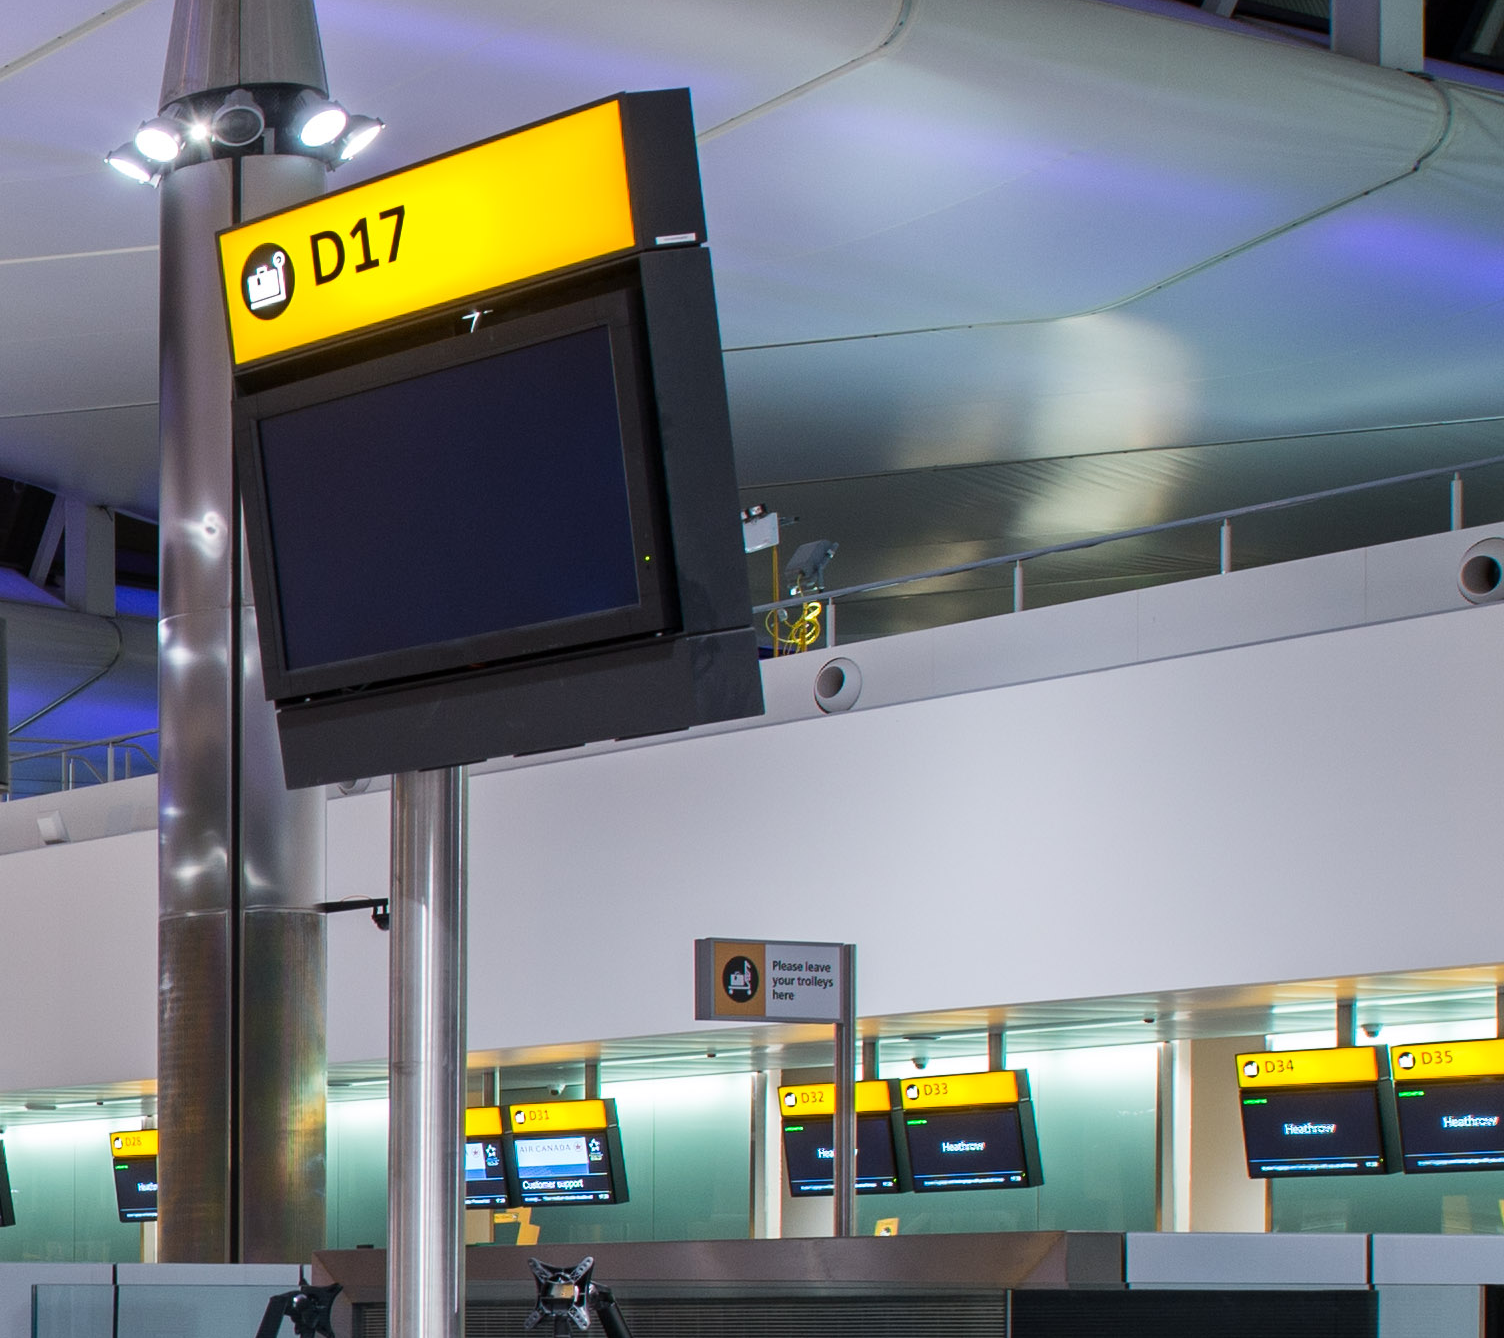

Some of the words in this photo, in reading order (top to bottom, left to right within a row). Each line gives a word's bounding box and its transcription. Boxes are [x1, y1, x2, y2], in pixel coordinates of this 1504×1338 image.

[309, 204, 406, 287] D17
[772, 960, 803, 972] Please
[804, 961, 832, 973] leave
[772, 976, 795, 988] your
[797, 975, 834, 990] trolleys
[772, 989, 795, 1001] here
[1421, 1050, 1454, 1065] D35
[1264, 1059, 1295, 1074] D34
[923, 1082, 949, 1096] D33
[800, 1090, 825, 1104] D32
[529, 1109, 550, 1121] D31
[1441, 1114, 1500, 1128] Heathrow
[1282, 1122, 1337, 1135] Heathrow
[519, 1145, 534, 1153] AIR
[535, 1143, 571, 1153] CANADA
[941, 1140, 986, 1153] Heathrow
[522, 1179, 556, 1190] Customer
[556, 1178, 584, 1191] support
